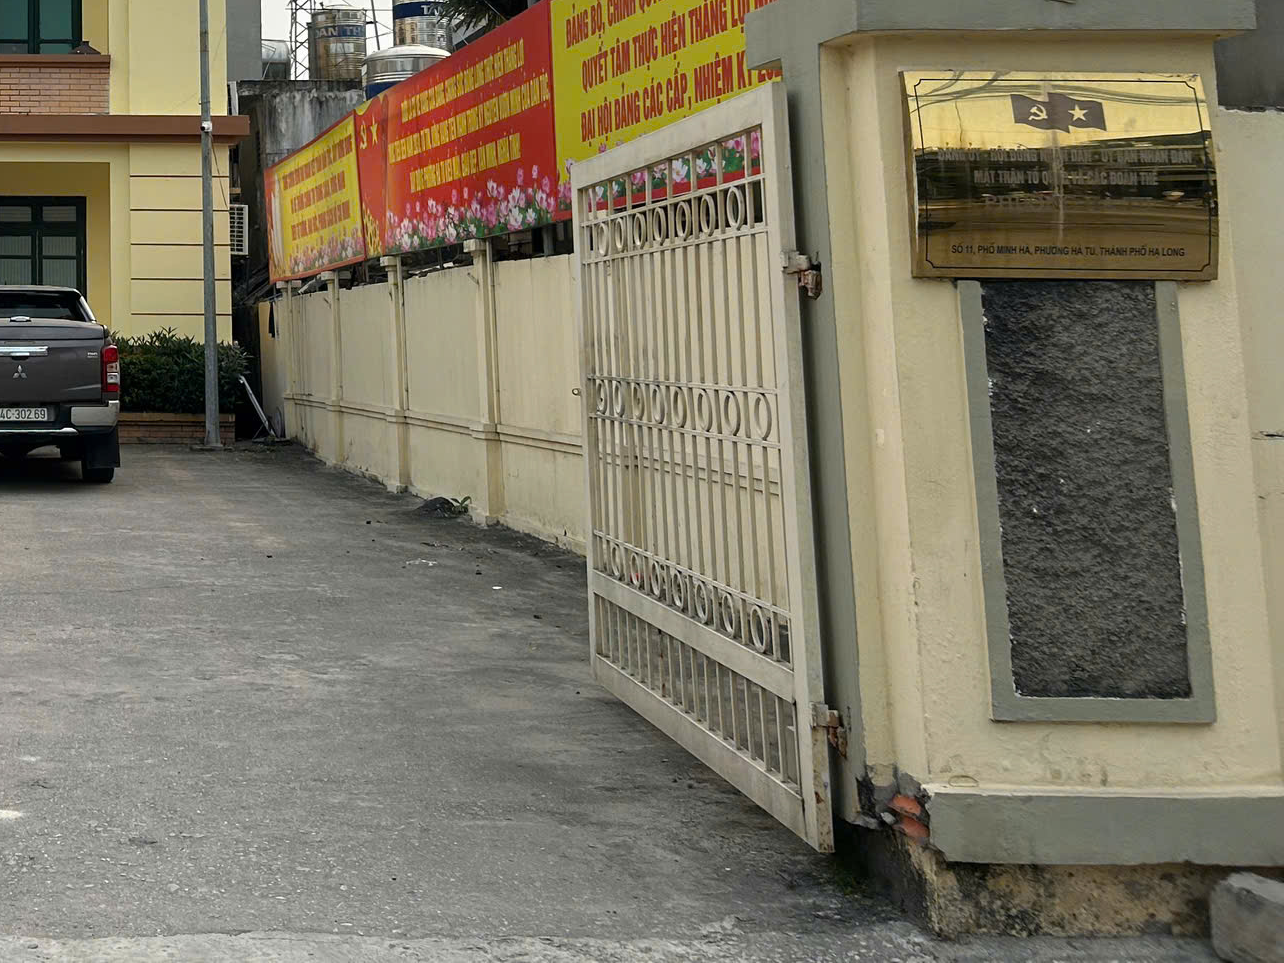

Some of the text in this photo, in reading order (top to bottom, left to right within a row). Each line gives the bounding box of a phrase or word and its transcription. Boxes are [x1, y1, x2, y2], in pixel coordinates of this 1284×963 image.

[566, 3, 589, 49] ĐẢNG
[581, 40, 608, 93] QUYẾT
[610, 38, 631, 78] TÂM
[633, 25, 658, 71] THỰC
[660, 10, 686, 60] HIỆN
[581, 107, 596, 148] ĐẠI
[597, 96, 613, 141] HỘI
[614, 82, 641, 131] ĐẢNG
[642, 76, 664, 121] CÁC
[666, 61, 692, 113] CẤP,
[694, 52, 734, 104] NHIỆM
[997, 245, 1017, 254] MINH
[1162, 248, 1185, 257] LONG
